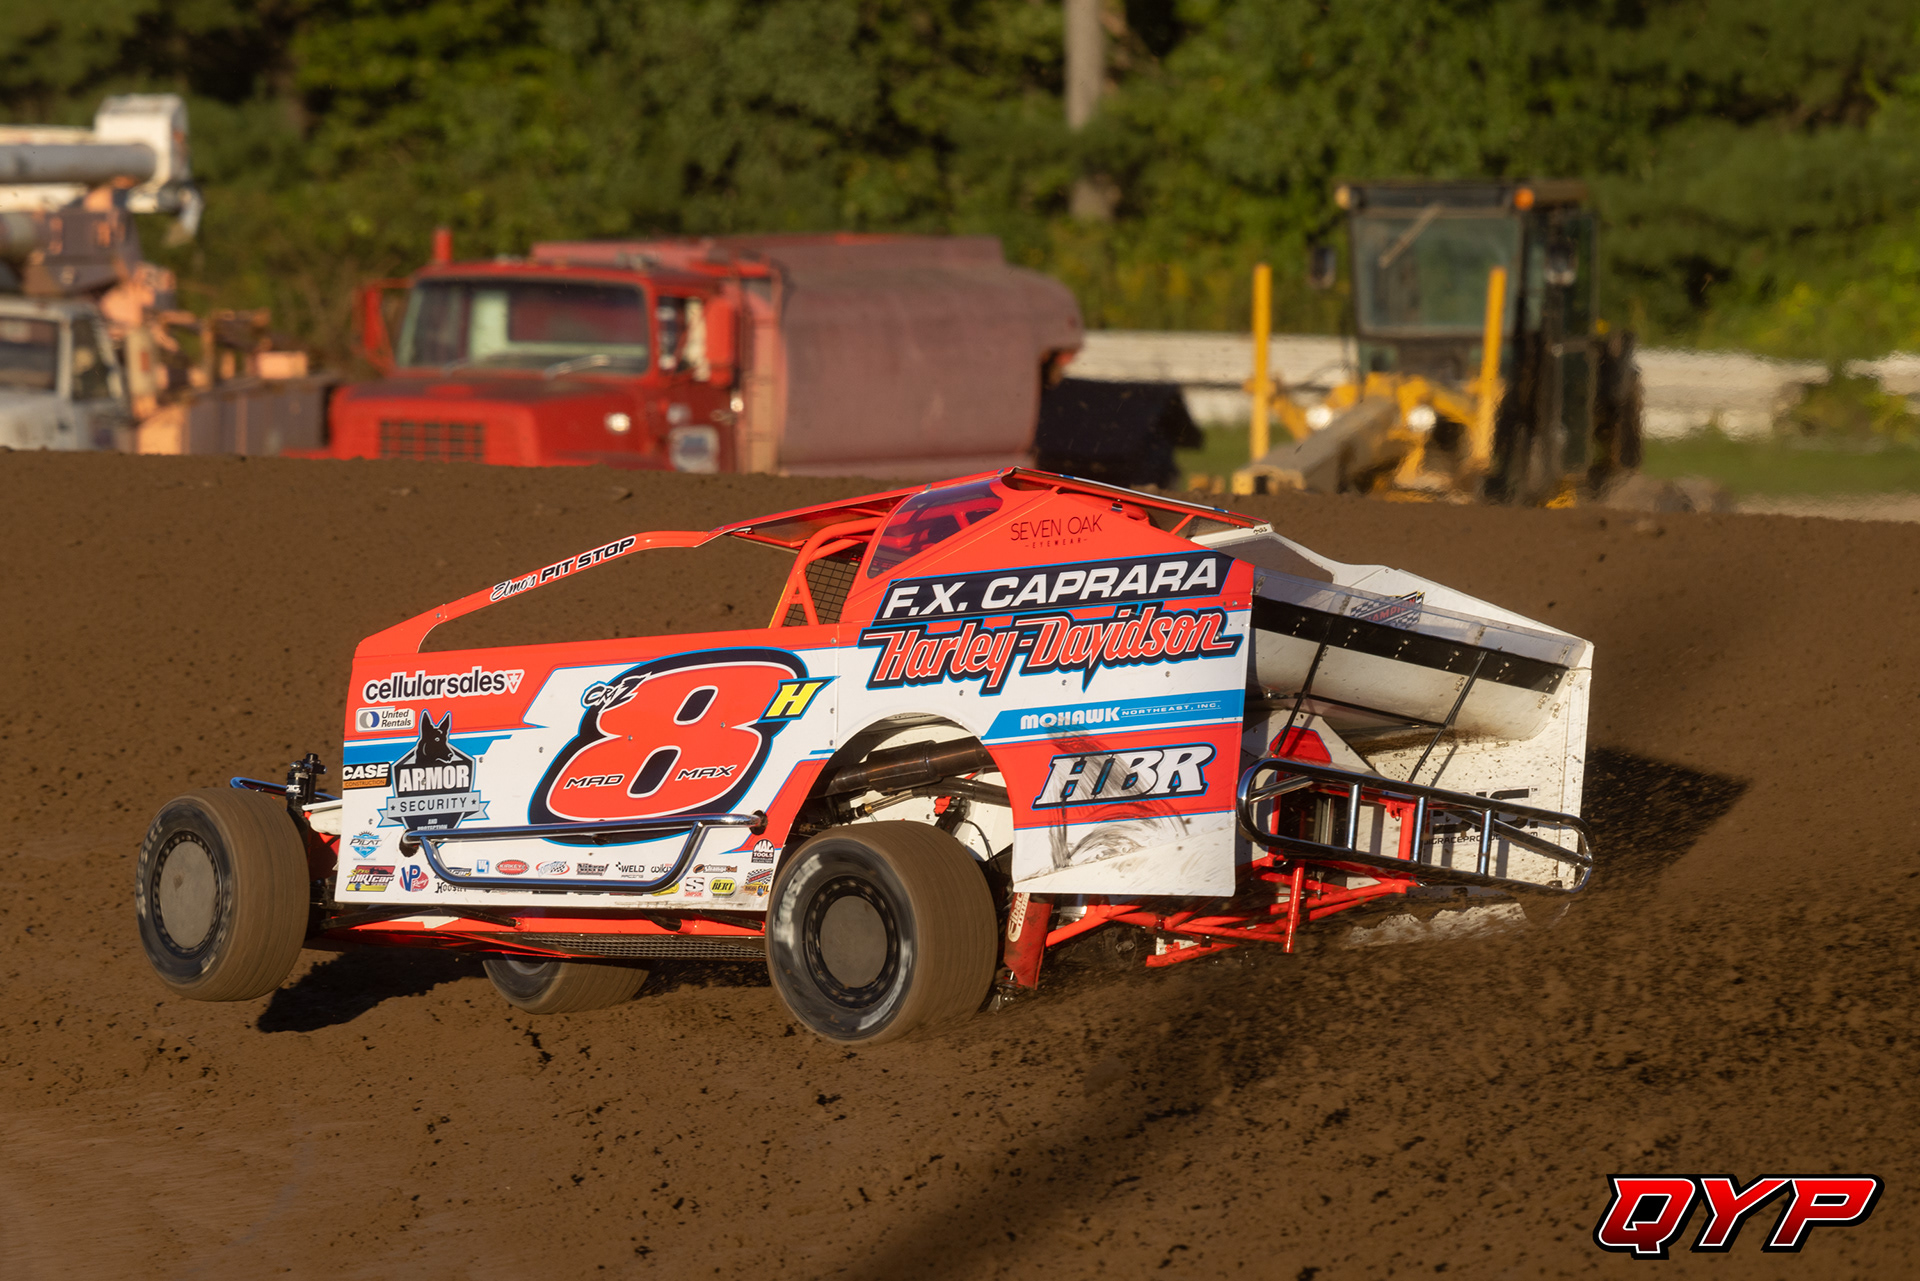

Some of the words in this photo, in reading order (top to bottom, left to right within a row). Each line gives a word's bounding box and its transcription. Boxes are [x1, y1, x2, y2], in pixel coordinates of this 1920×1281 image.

[1010, 517, 1062, 541] SEVEN
[1067, 513, 1103, 535] OAK
[1032, 538, 1082, 549] EYEWEAR
[490, 575, 537, 600] Elmo's
[541, 558, 574, 582] PIT
[577, 537, 635, 568] STOP
[882, 581, 968, 619] F.X.
[981, 557, 1217, 610] CAPRARA
[861, 604, 1237, 692] Harley-Davidson
[364, 669, 506, 701] cellularsales
[765, 681, 825, 719] H
[381, 709, 410, 720] United
[381, 718, 412, 728] Rentals
[1020, 706, 1121, 730] MOHAWK
[1121, 704, 1195, 716] NORTHEAST,
[1196, 702, 1222, 710] INC.
[540, 655, 803, 832] 8
[343, 763, 390, 781] CASE
[344, 779, 386, 788] CONSTRUCTION
[398, 764, 470, 792] ARMOR
[564, 773, 625, 789] MAD
[675, 765, 737, 781] MAX
[1034, 746, 1215, 806] HBR
[400, 796, 468, 813] SECURITY
[349, 838, 382, 846] PILAT
[753, 839, 774, 852] MAC
[400, 865, 421, 892] VP
[621, 864, 645, 873] WELD
[711, 881, 735, 891] BERT
[1008, 892, 1025, 942] Eibac
